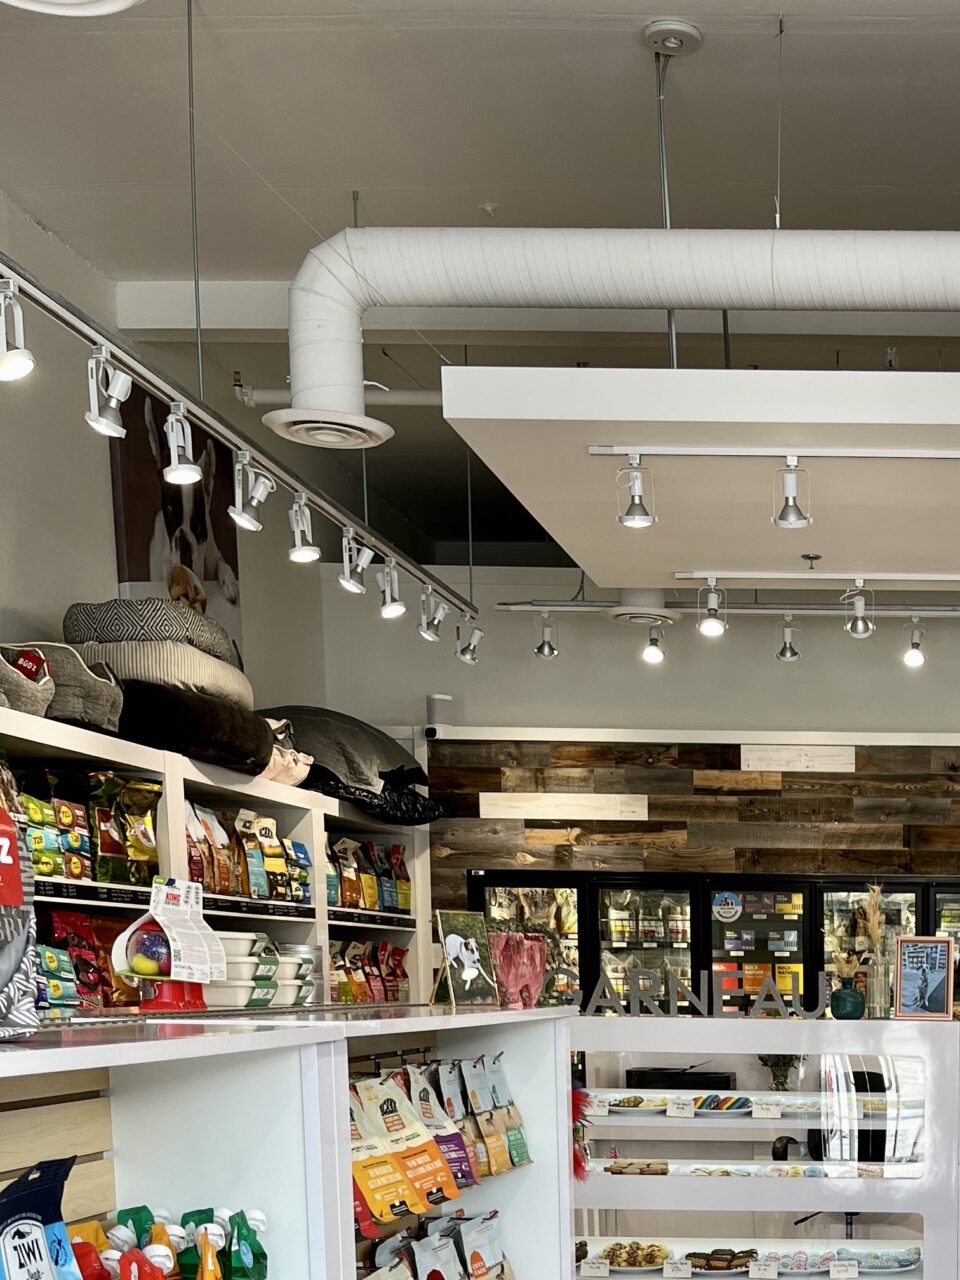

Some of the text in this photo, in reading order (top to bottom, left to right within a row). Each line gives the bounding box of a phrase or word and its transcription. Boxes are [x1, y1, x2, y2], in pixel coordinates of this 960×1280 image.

[165, 891, 181, 902] KONG
[543, 967, 826, 1018] GARNEAU
[13, 1239, 43, 1269] ZIWI
